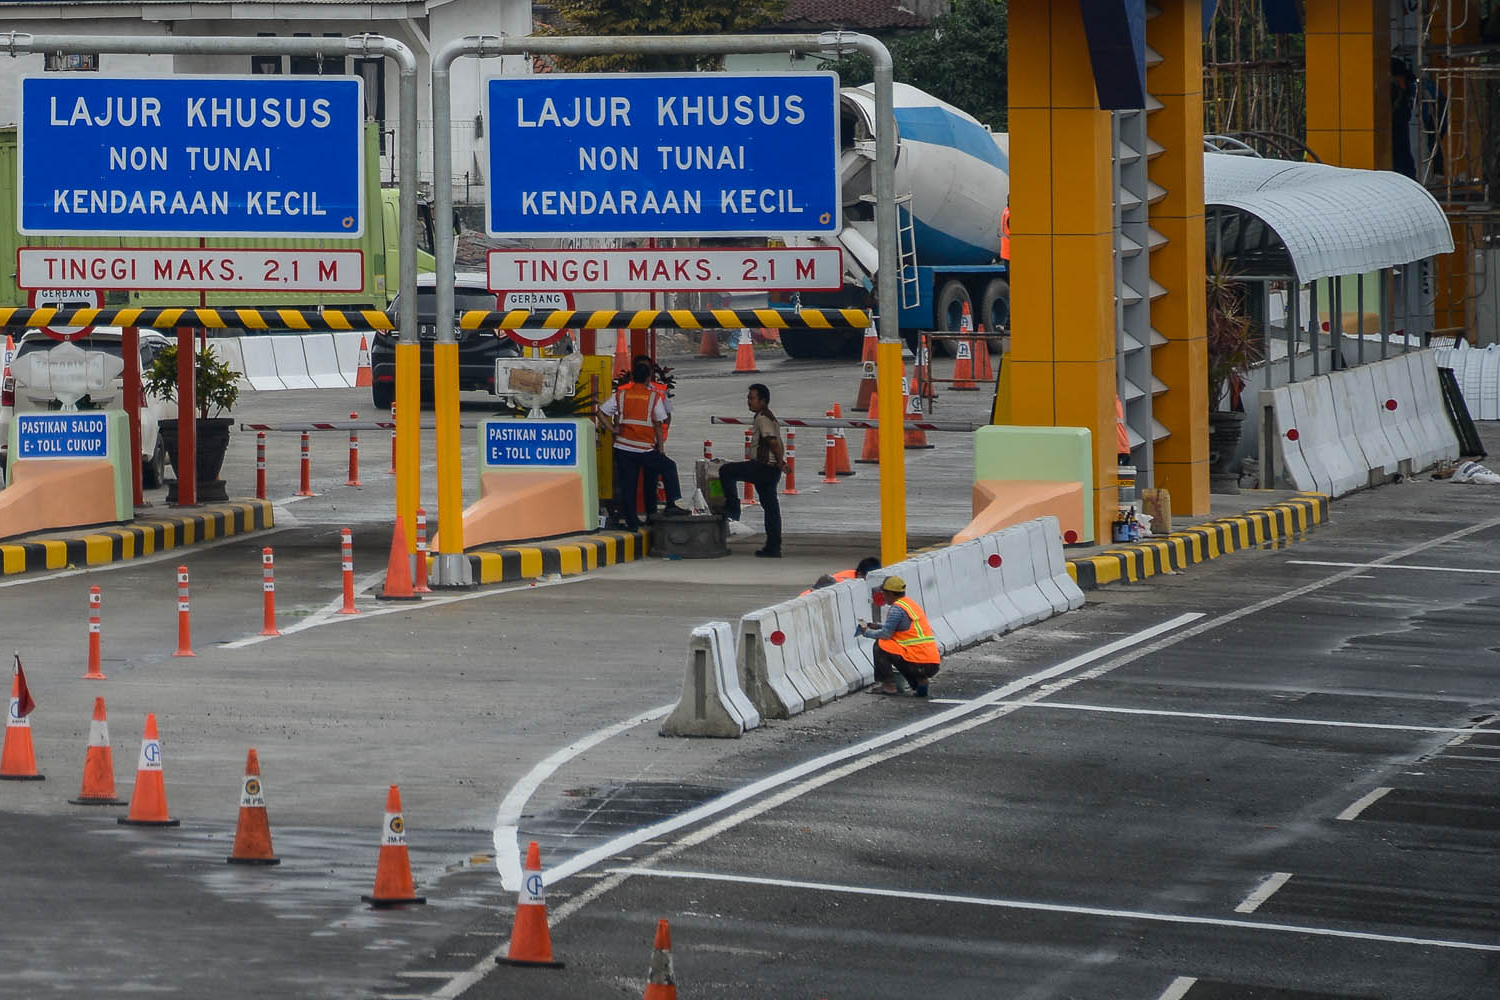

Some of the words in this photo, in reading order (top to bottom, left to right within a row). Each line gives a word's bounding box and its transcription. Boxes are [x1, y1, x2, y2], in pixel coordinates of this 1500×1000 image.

[49, 96, 161, 127] LAJUR
[187, 97, 332, 129] KHUSUS
[517, 96, 631, 128] LAJUR
[658, 95, 806, 127] KHUSUS
[109, 146, 168, 172] NON
[186, 146, 272, 172] TUNAI
[579, 146, 640, 172] NON
[657, 145, 746, 171] TUNAI
[53, 189, 229, 216] KENDARAAN
[247, 191, 328, 217] KECIL
[522, 190, 702, 217] KENDARAAN
[721, 189, 804, 215] KECIL
[44, 258, 136, 281] TINGGI
[154, 259, 244, 282] MAKS.
[264, 260, 300, 284] 2,1
[318, 260, 339, 282] M
[514, 260, 609, 282] TINGGI
[629, 259, 722, 282] MAKS.
[742, 258, 776, 283] 2,1
[796, 259, 816, 281] M
[41, 290, 91, 298] GERBANG
[510, 293, 561, 304] GERBANG
[21, 422, 68, 434] PASTIKAN
[71, 420, 104, 433] SALDO
[489, 429, 537, 441] PASTIKAN
[541, 429, 573, 442] SALDO
[67, 439, 102, 452] CUKUP
[536, 448, 571, 461] CUKUP
